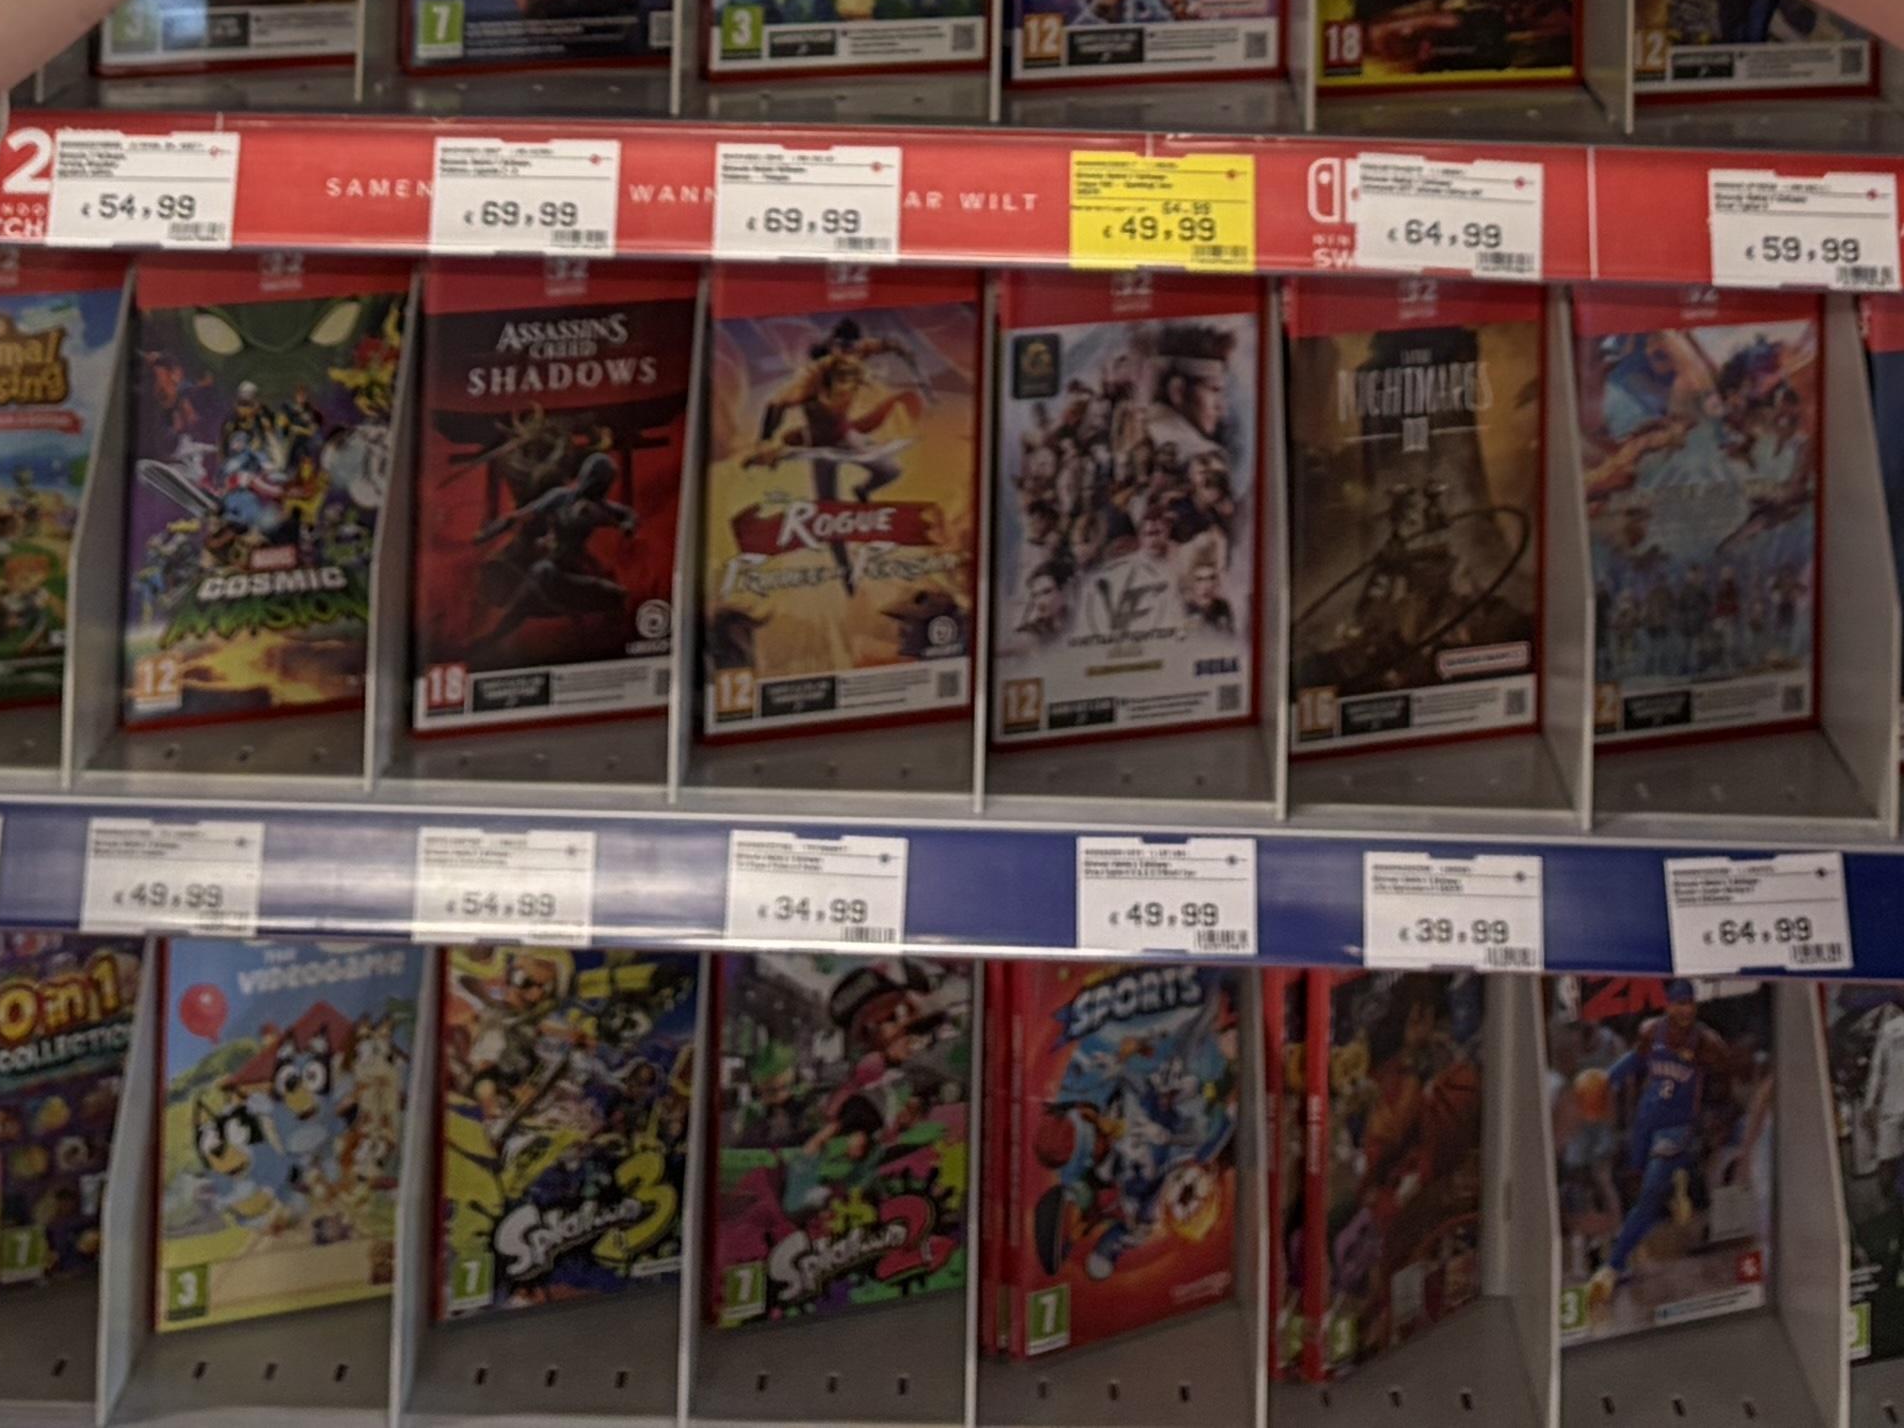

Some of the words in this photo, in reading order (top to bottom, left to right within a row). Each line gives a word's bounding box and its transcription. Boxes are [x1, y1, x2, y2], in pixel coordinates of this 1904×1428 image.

[431, 5, 450, 41] 7
[732, 11, 753, 45] 3
[1327, 25, 1363, 64] 18
[97, 193, 196, 221] 54,99
[325, 177, 434, 199] SAMEN
[959, 191, 1039, 212] WILT
[480, 199, 579, 227] 69,99
[764, 207, 862, 234] 69,99
[1119, 215, 1217, 243] 49,99
[1404, 219, 1503, 249] 64,99
[1761, 236, 1861, 264] 59,99
[467, 356, 659, 398] SHADOWS
[199, 565, 348, 603] COSMIC
[141, 658, 178, 695] 12
[429, 665, 464, 701] 18
[719, 675, 753, 709] 12
[129, 881, 224, 908] 49,99
[462, 891, 558, 917] 54,99
[774, 895, 869, 924] 34,99
[1125, 901, 1220, 928] 49,99
[1415, 917, 1510, 945] 39,99
[1718, 916, 1814, 946] 64,99
[1069, 968, 1202, 1032] SPORTS
[177, 1270, 198, 1306] 3
